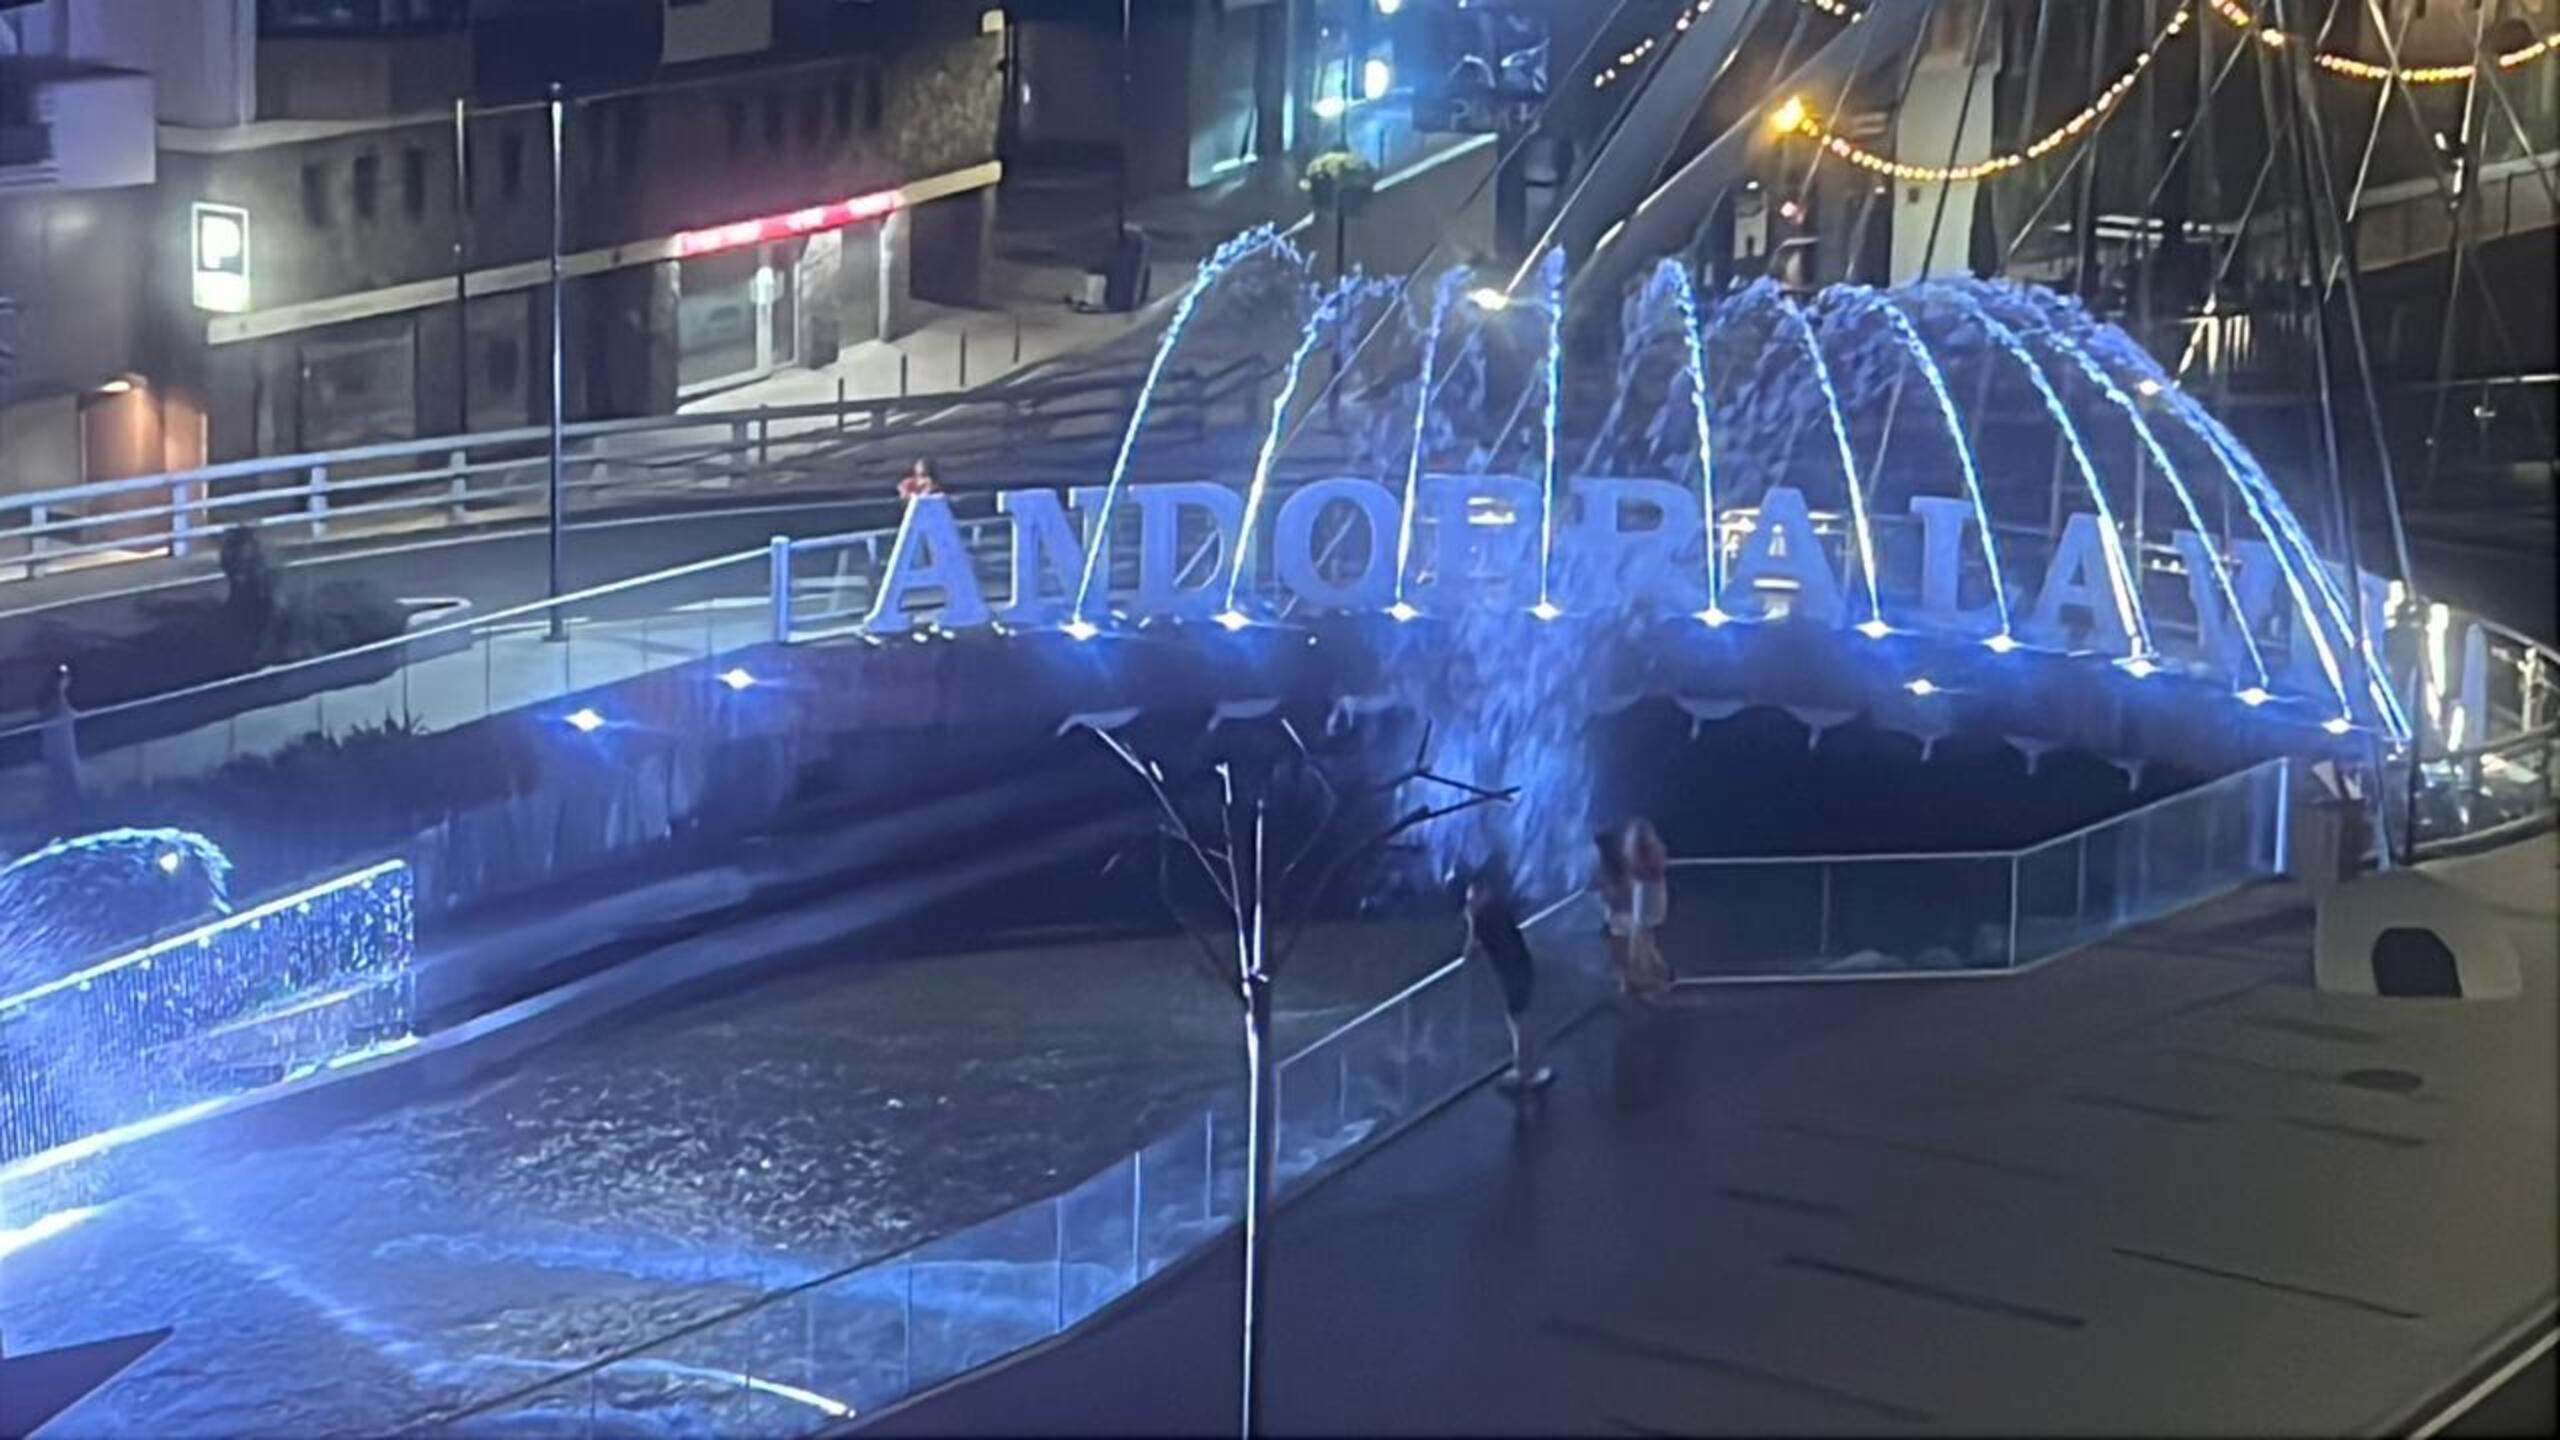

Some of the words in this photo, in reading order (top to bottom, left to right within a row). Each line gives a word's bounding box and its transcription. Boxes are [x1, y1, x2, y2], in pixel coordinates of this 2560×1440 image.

[202, 216, 240, 269] P
[863, 476, 1855, 629] ANDORRA
[1909, 497, 2135, 656] LA
